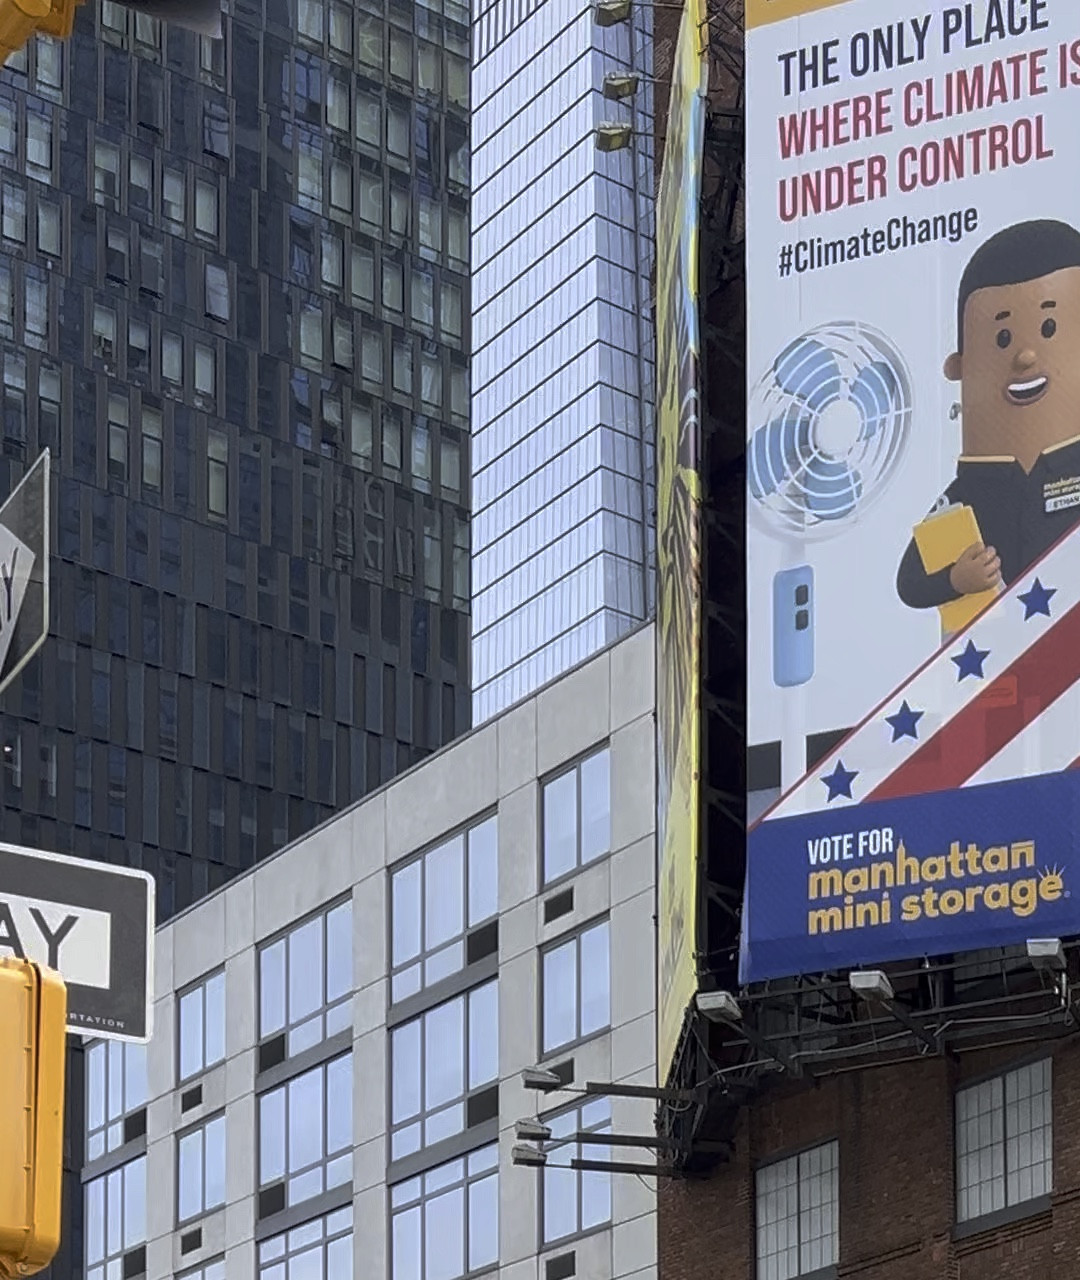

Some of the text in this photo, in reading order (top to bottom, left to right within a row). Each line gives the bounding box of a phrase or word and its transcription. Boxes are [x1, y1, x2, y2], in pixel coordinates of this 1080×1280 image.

[777, 0, 1049, 96] THE ONLY PLACE
[778, 88, 893, 160] WHERE
[903, 48, 1049, 127] CLIMATE
[778, 114, 1054, 222] UNDER CONTROL
[778, 207, 978, 277] #ClimateChange
[807, 827, 894, 865] VOTE FOR
[808, 839, 1035, 900] manhattan
[808, 866, 1064, 935] mini storage
